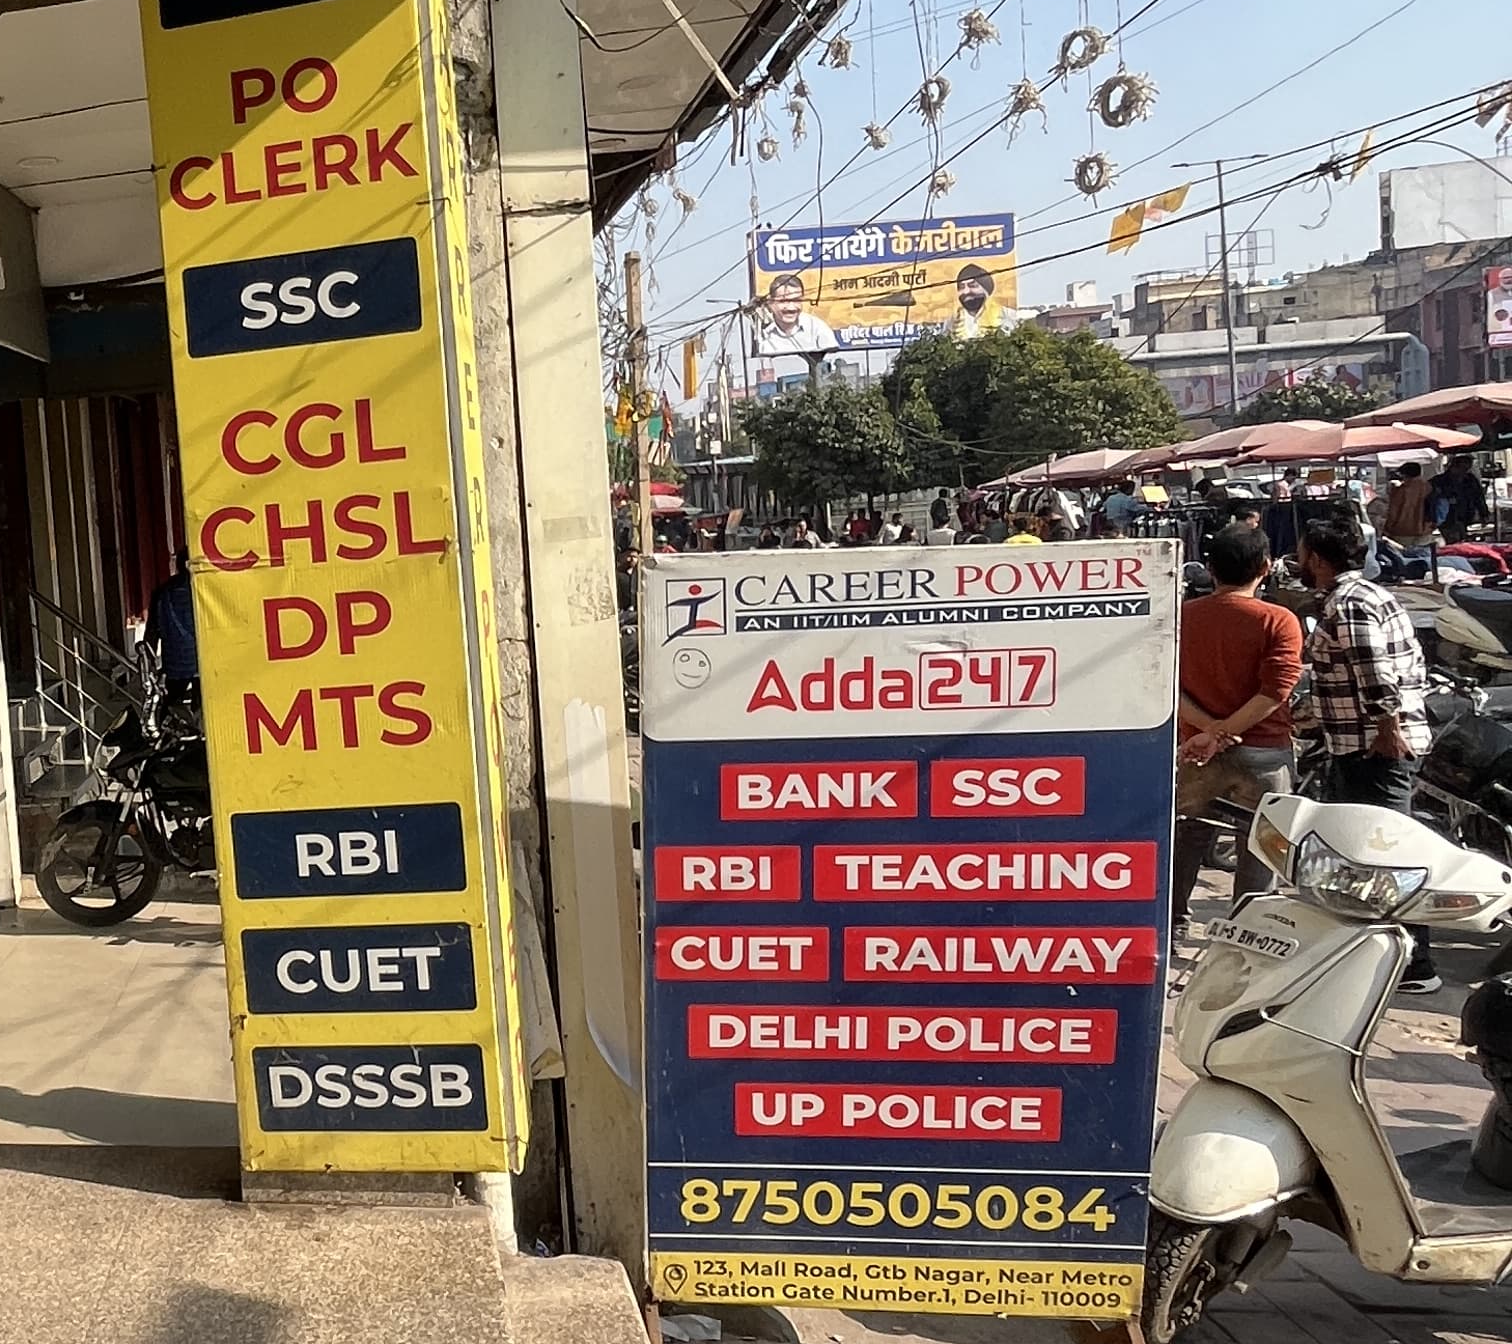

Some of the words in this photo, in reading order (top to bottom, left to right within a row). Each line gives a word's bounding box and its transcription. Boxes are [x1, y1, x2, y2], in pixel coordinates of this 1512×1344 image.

[230, 57, 338, 124] PO
[169, 123, 419, 211] CLERK
[764, 233, 816, 265] फिर
[888, 220, 1005, 256] केजरीवाल
[240, 271, 361, 330] SSC
[863, 271, 899, 288] आदमी
[221, 398, 407, 475] CGL
[200, 492, 447, 572] CHSL
[735, 568, 940, 606] CAREER
[954, 557, 1147, 597] POWER
[263, 590, 393, 662] DP
[743, 616, 780, 630] AN
[792, 612, 872, 629] IIT/IIM
[883, 608, 990, 626] ALUMNI
[1002, 601, 1143, 621] COMPANY
[243, 681, 433, 755] MTS
[737, 770, 898, 810] BANK
[951, 767, 1062, 807] SSC
[295, 830, 399, 878] RBI
[682, 857, 772, 891] RBI
[835, 852, 1132, 891] TEACHING
[275, 946, 440, 994] CUET
[670, 936, 813, 971] CUET
[864, 937, 1132, 973] RAILWAY
[708, 1014, 867, 1050] DELHI
[887, 1017, 1092, 1053] POLICE
[267, 1064, 472, 1109] DSSSB
[751, 1092, 825, 1126] UP
[841, 1094, 1042, 1131] POLICE
[680, 1178, 1116, 1232] 8750505084
[693, 1259, 734, 1279] 123,
[740, 1260, 786, 1278] Mall
[794, 1262, 858, 1282] Road,
[865, 1264, 907, 1281] Gtb
[914, 1265, 990, 1286] Nagar,
[998, 1268, 1055, 1285] Near
[1062, 1269, 1133, 1287] Metro
[694, 1281, 776, 1299] Station
[782, 1284, 835, 1300] Gate
[964, 1289, 1035, 1306] Delhi-
[1041, 1290, 1121, 1308] 110009
